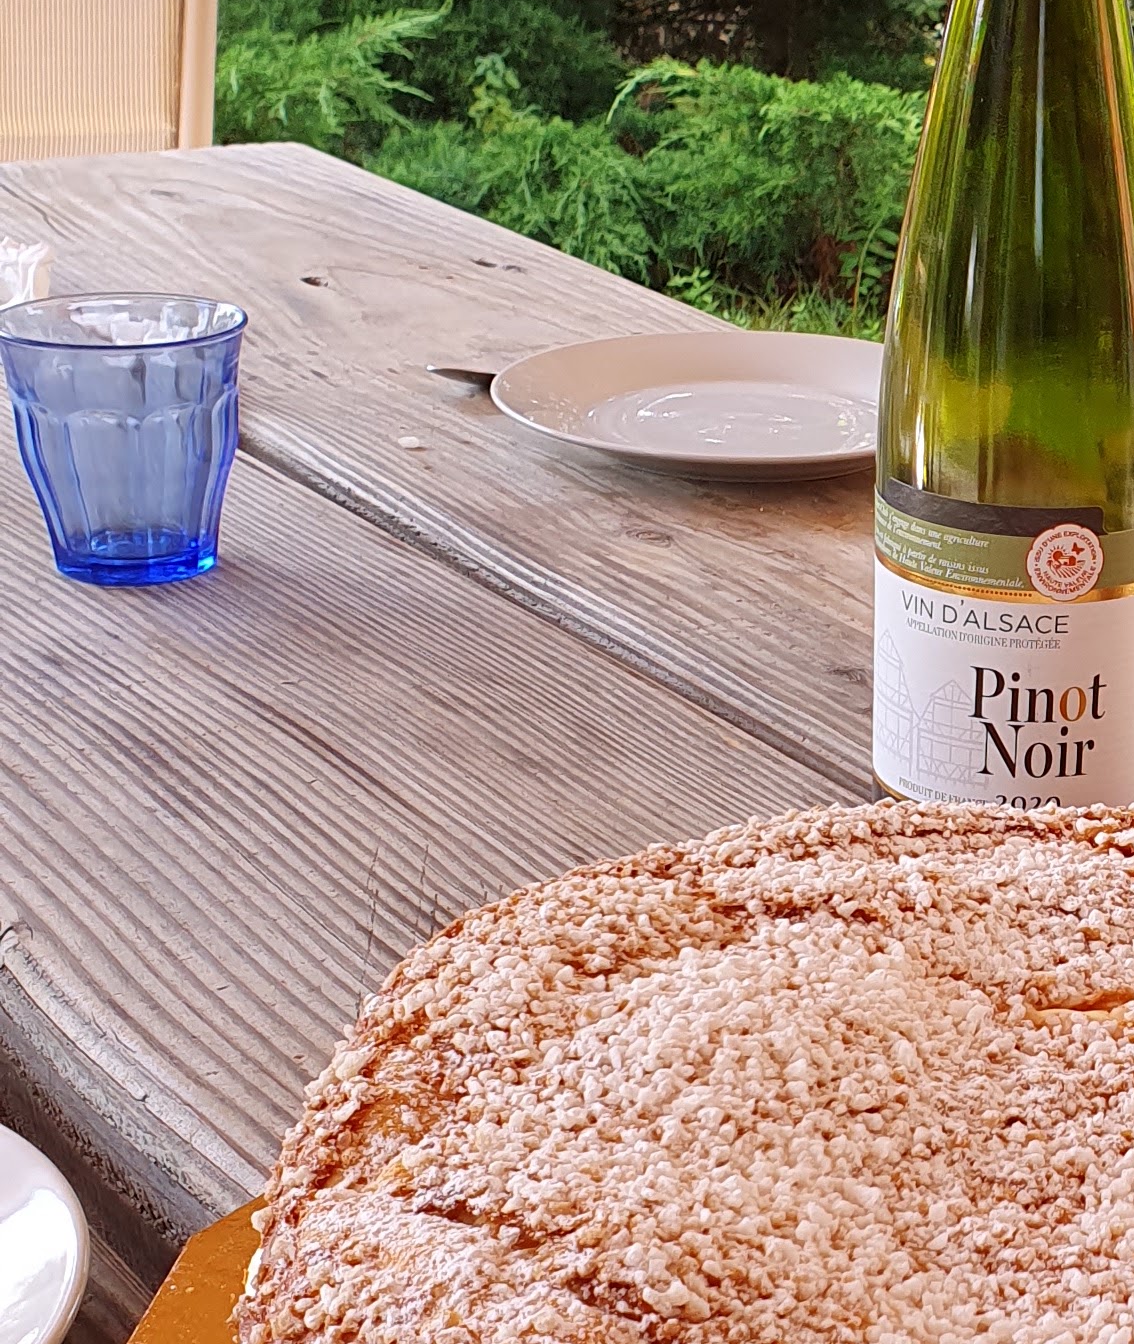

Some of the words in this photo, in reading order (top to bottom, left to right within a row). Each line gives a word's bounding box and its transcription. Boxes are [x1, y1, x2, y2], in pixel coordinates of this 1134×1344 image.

[943, 533, 990, 549] agriculture
[939, 557, 965, 571] raisins
[968, 562, 990, 575] issus
[901, 590, 934, 619] VIN
[943, 599, 1070, 634] D'ALSACE
[906, 617, 958, 641] APPELLATION
[959, 633, 1008, 648] D'ORIGINE
[1009, 636, 1061, 650] PROTÉGÉE
[968, 665, 1107, 724] Pinot
[976, 721, 1095, 779] Noir
[898, 776, 934, 799] PRODUIT
[934, 790, 947, 803] DE
